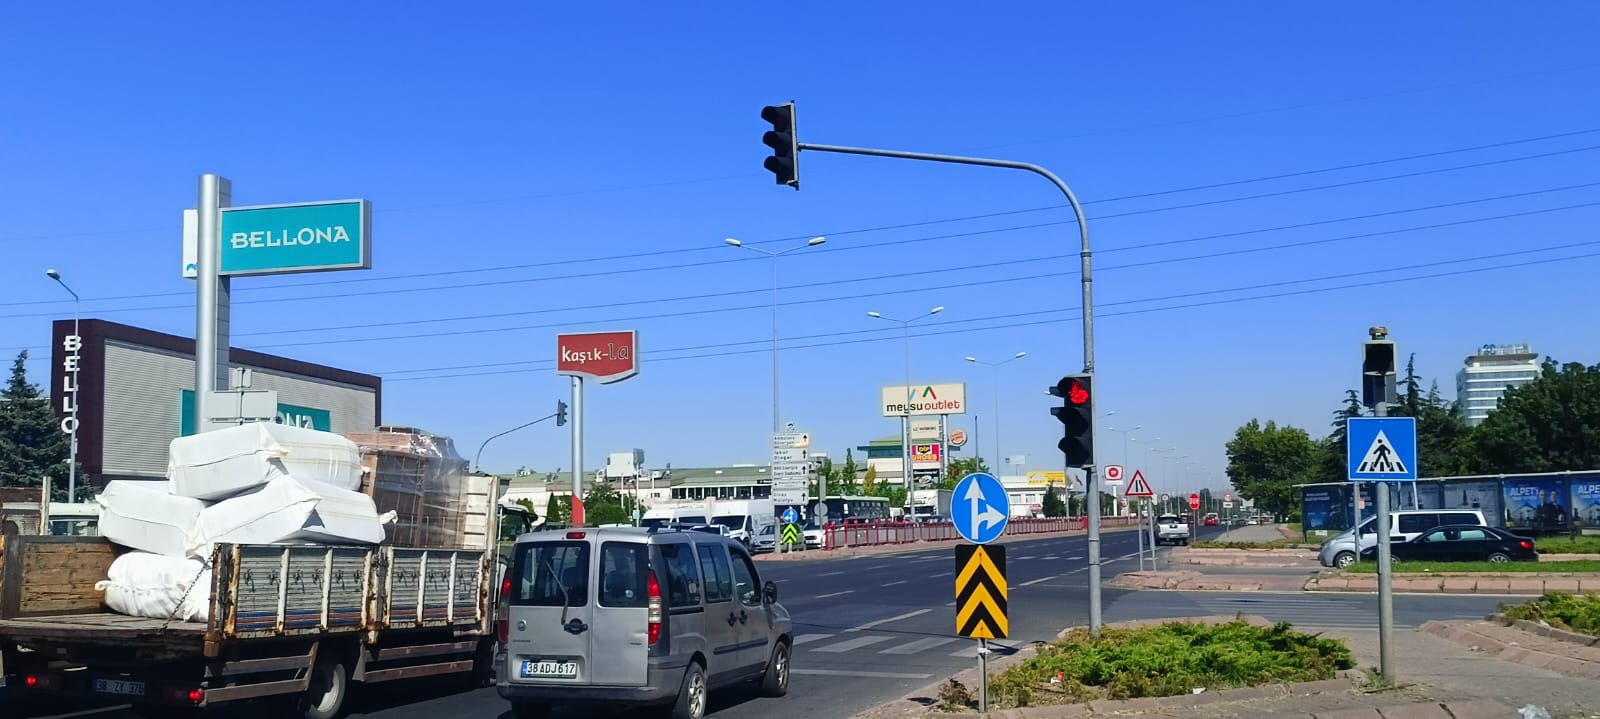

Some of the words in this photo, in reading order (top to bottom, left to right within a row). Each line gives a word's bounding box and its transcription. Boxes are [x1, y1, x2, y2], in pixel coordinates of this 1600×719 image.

[230, 225, 350, 249] BELLONA
[561, 342, 629, 364] kaşık-la
[61, 335, 82, 462] BELLO
[886, 403, 923, 413] meysu
[924, 400, 960, 410] outlet
[527, 663, 539, 673] 38
[540, 663, 557, 673] ADJ
[558, 663, 576, 674] 617
